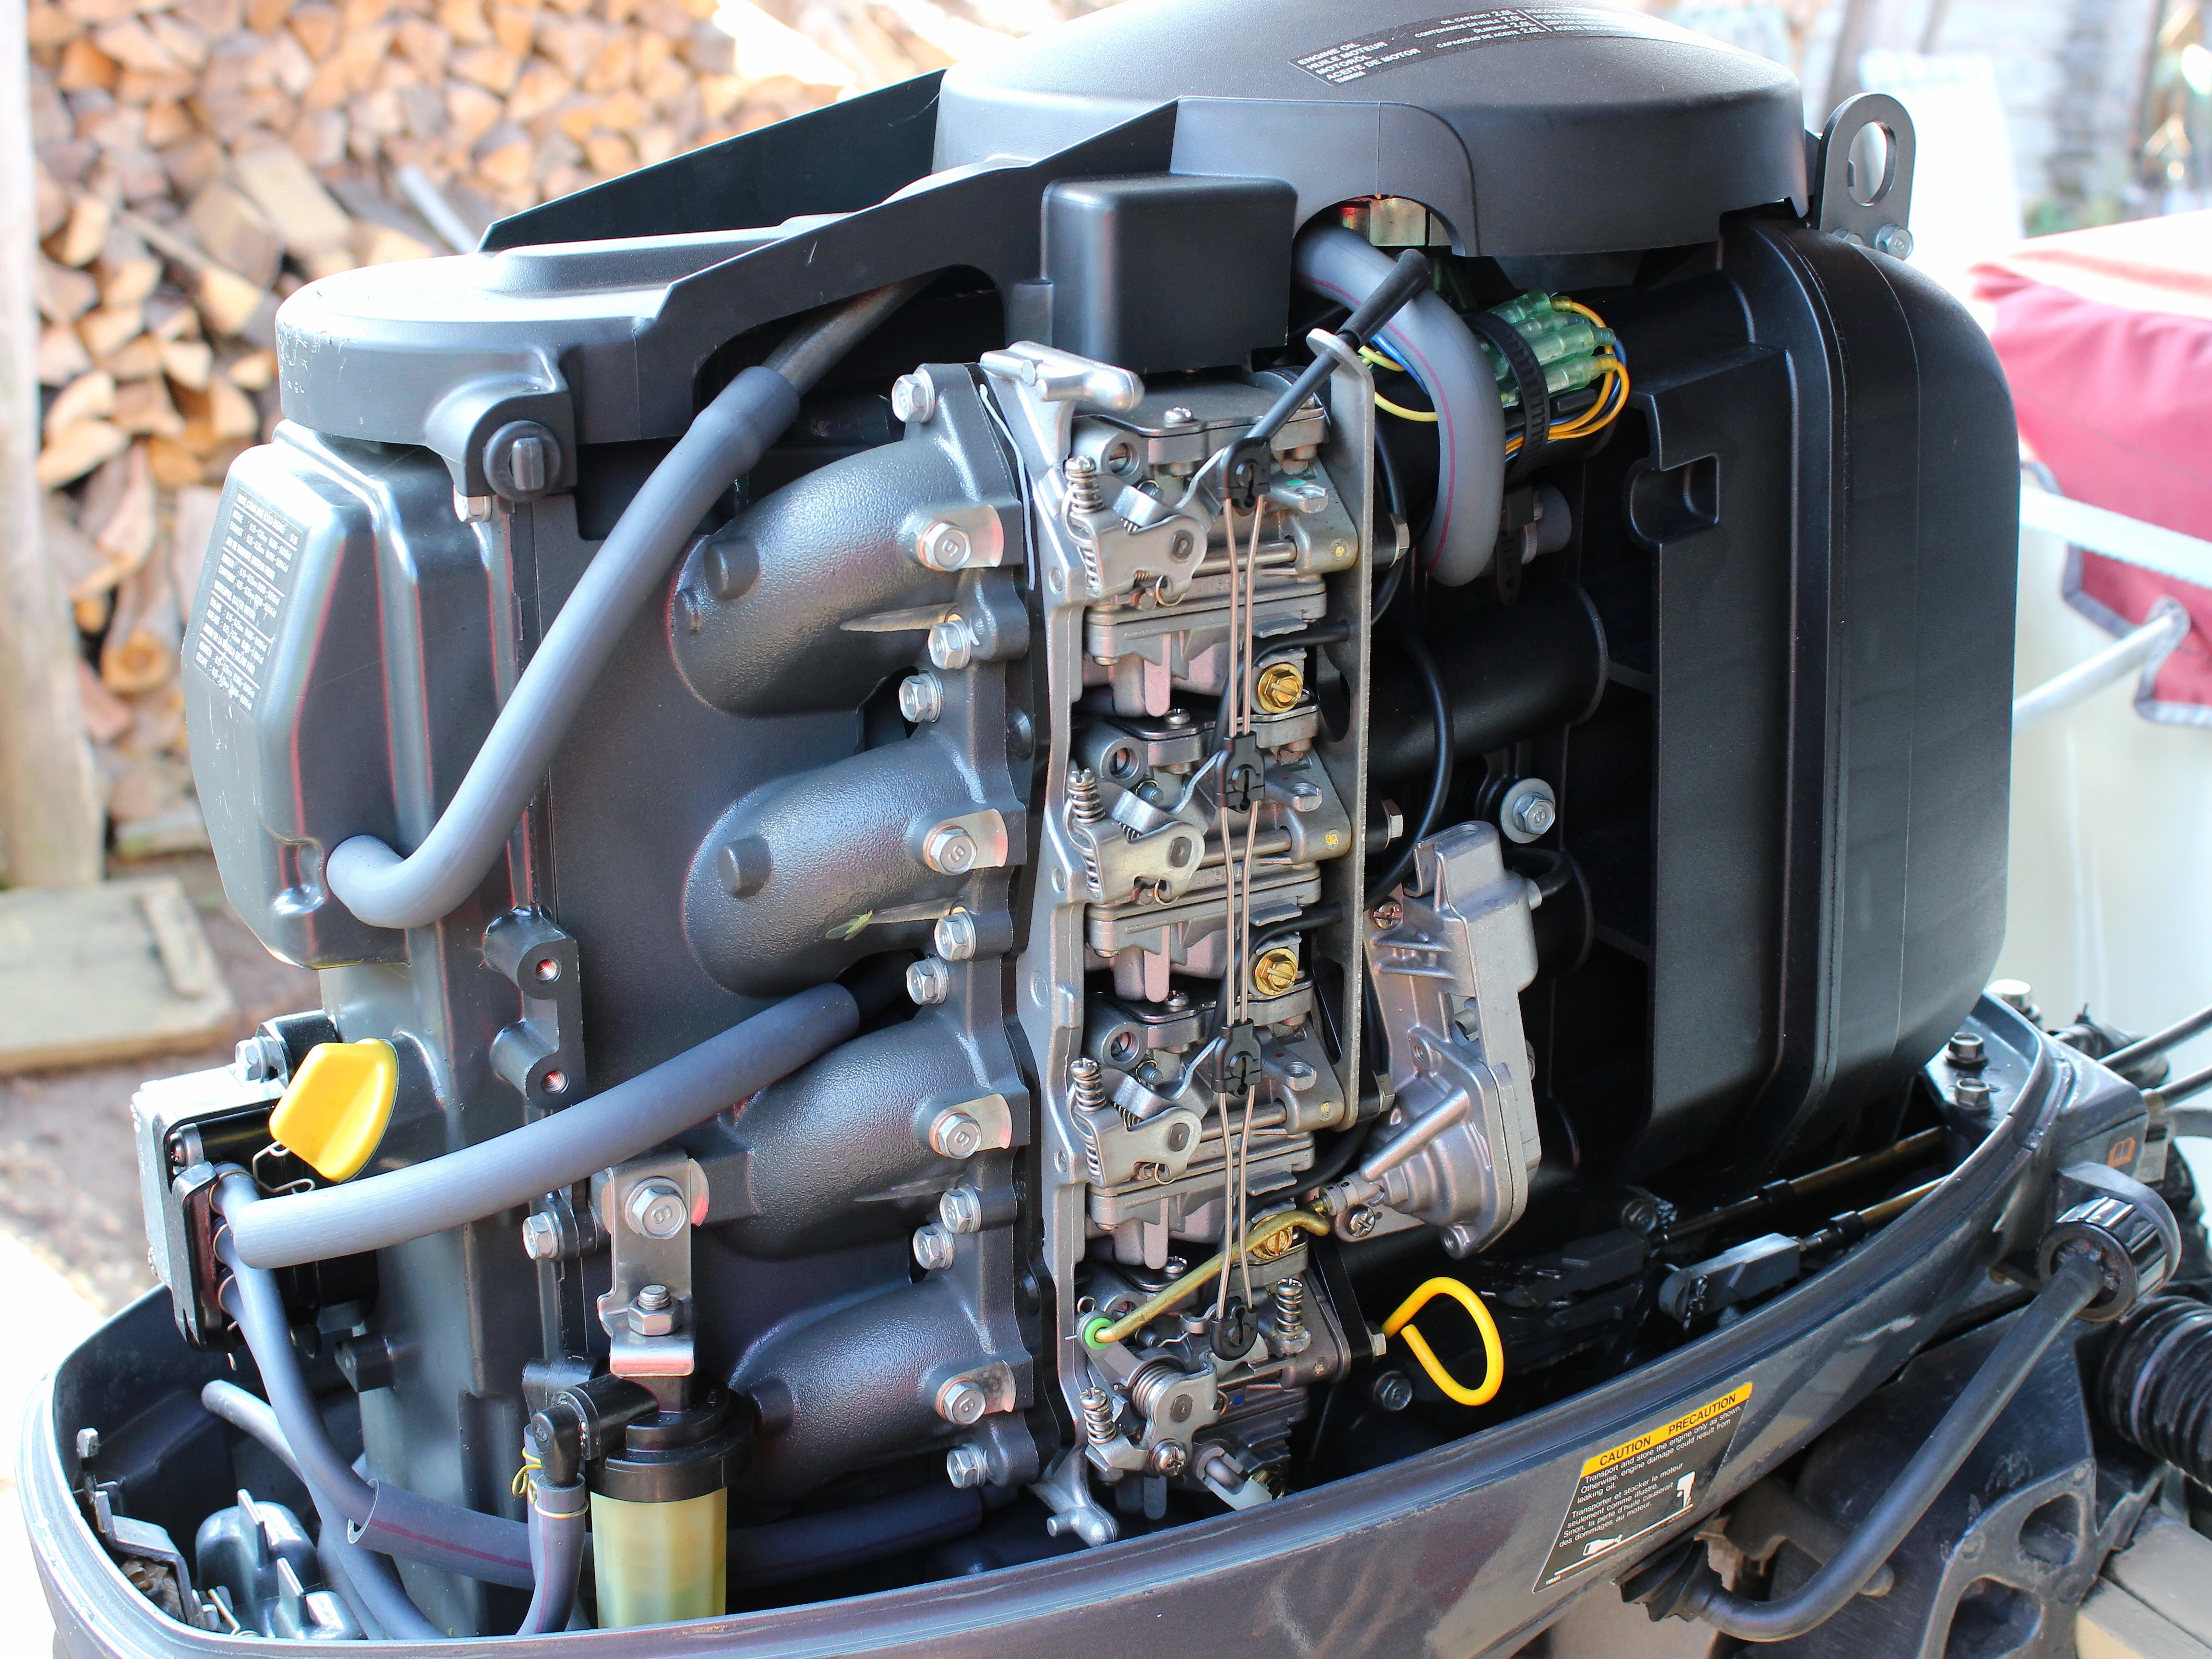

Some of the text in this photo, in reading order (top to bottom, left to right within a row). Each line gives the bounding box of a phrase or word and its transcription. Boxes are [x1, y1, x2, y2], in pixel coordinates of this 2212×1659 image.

[1414, 24, 1467, 38] CONTENANCE
[1453, 13, 1491, 22] CAPACITY
[1297, 42, 1360, 66] ENGINE OIL
[1306, 41, 1388, 70] HUILE MOTEUR
[1436, 36, 1480, 48] CAPACIDAD
[1315, 54, 1372, 75] MOTORÖL
[1326, 48, 1421, 80] ACEITE DE MOTOR
[1334, 72, 1367, 84] YAMAHA
[1599, 1393, 1736, 1466] CAUTION PRECAUTION
[1585, 1406, 1741, 1484] Transport and store the engine only as shown.
[1621, 1461, 1645, 1477] engine
[1647, 1447, 1674, 1465] damage
[1676, 1435, 1695, 1451] could
[1696, 1426, 1715, 1441] result
[1716, 1418, 1731, 1430] from
[1572, 1496, 1612, 1518] Transporter
[1614, 1491, 1622, 1500] et
[1623, 1479, 1649, 1496] stocker
[1660, 1462, 1683, 1478] moteur
[1577, 1482, 1616, 1504] leaking oil.
[1597, 1511, 1615, 1524] perte
[1617, 1499, 1641, 1514] d'huile
[1642, 1481, 1673, 1502] causerait
[1559, 1501, 1651, 1548] des dommages au moteur.
[1567, 1507, 1604, 1528] seulement
[1606, 1495, 1632, 1511] comme
